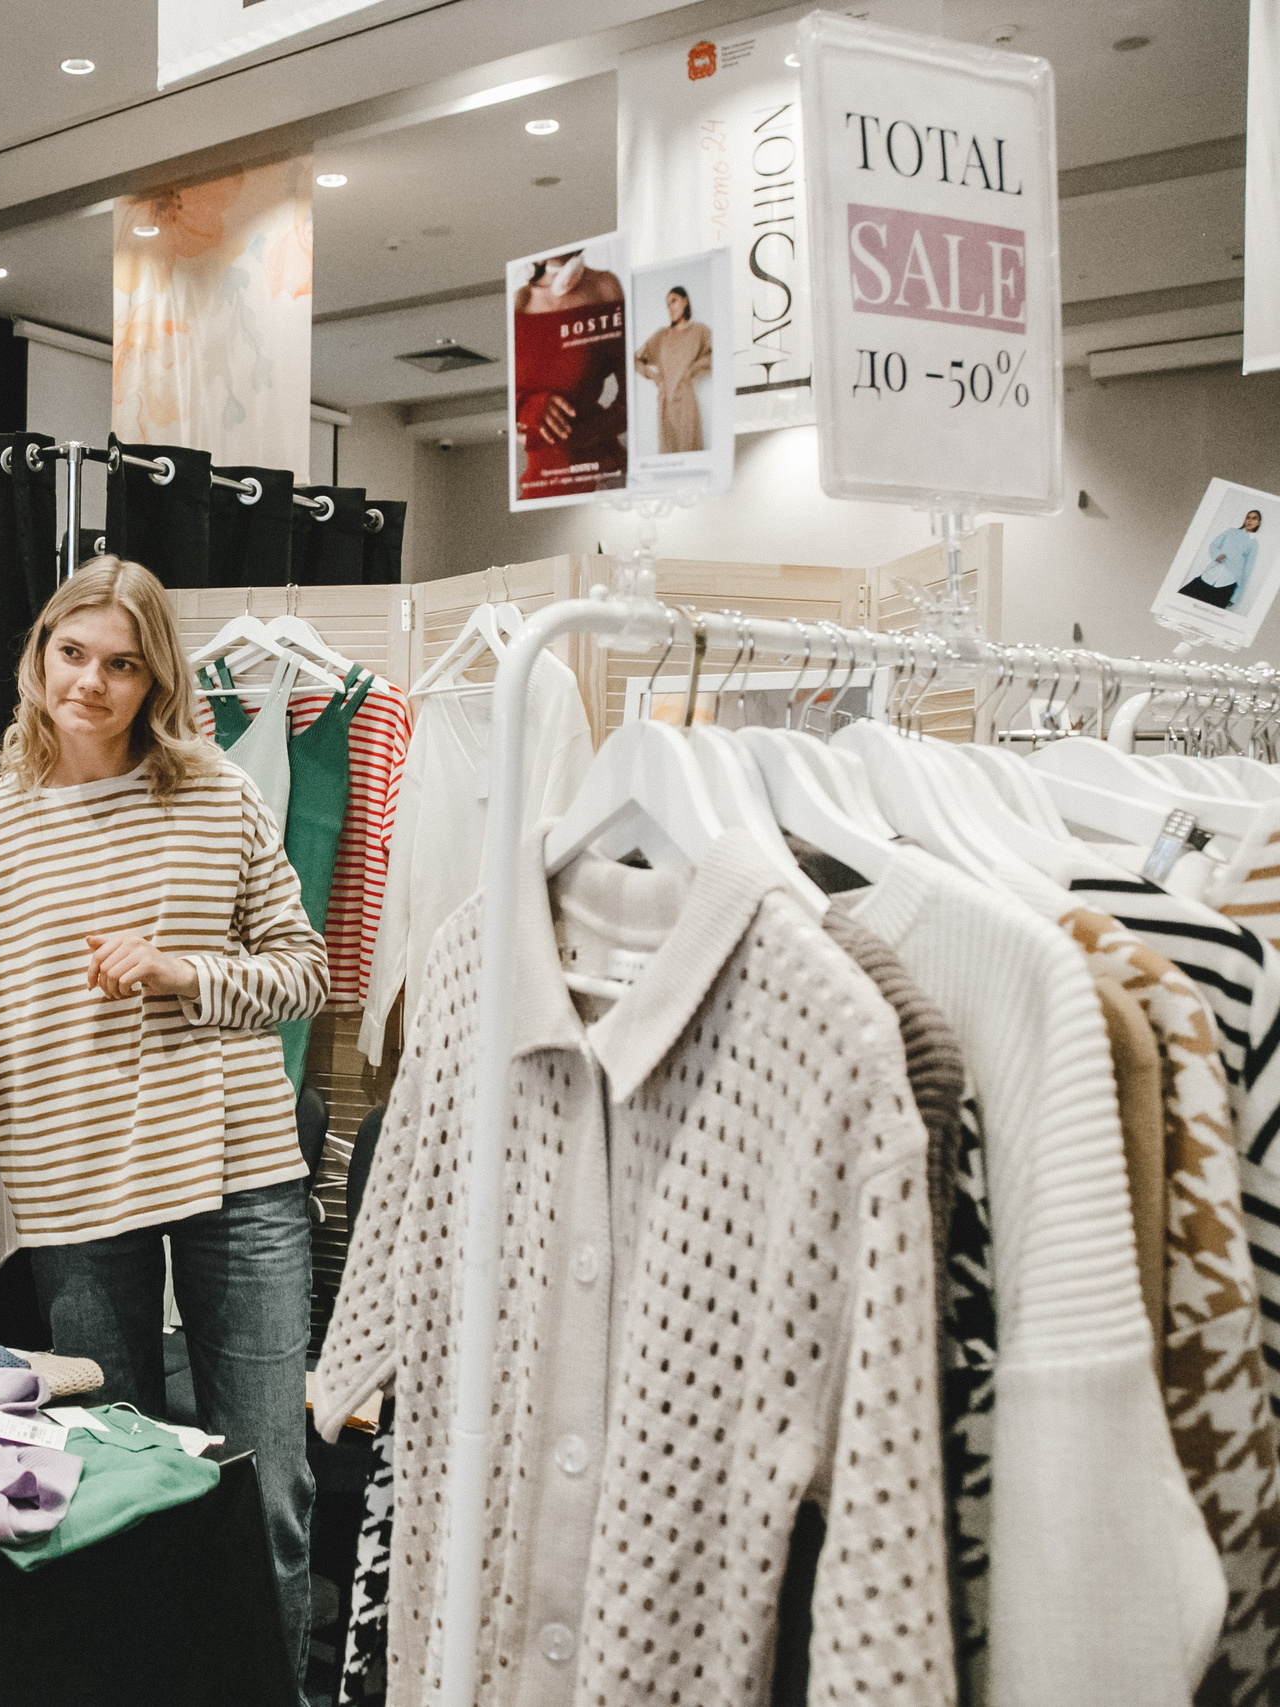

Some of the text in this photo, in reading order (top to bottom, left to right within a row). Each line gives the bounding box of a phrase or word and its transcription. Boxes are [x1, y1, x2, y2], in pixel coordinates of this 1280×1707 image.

[700, 119, 727, 153] 24
[845, 112, 1023, 196] TOTAL
[733, 102, 812, 396] FASHION
[849, 219, 1025, 323] SALE
[925, 350, 1030, 408] -50%
